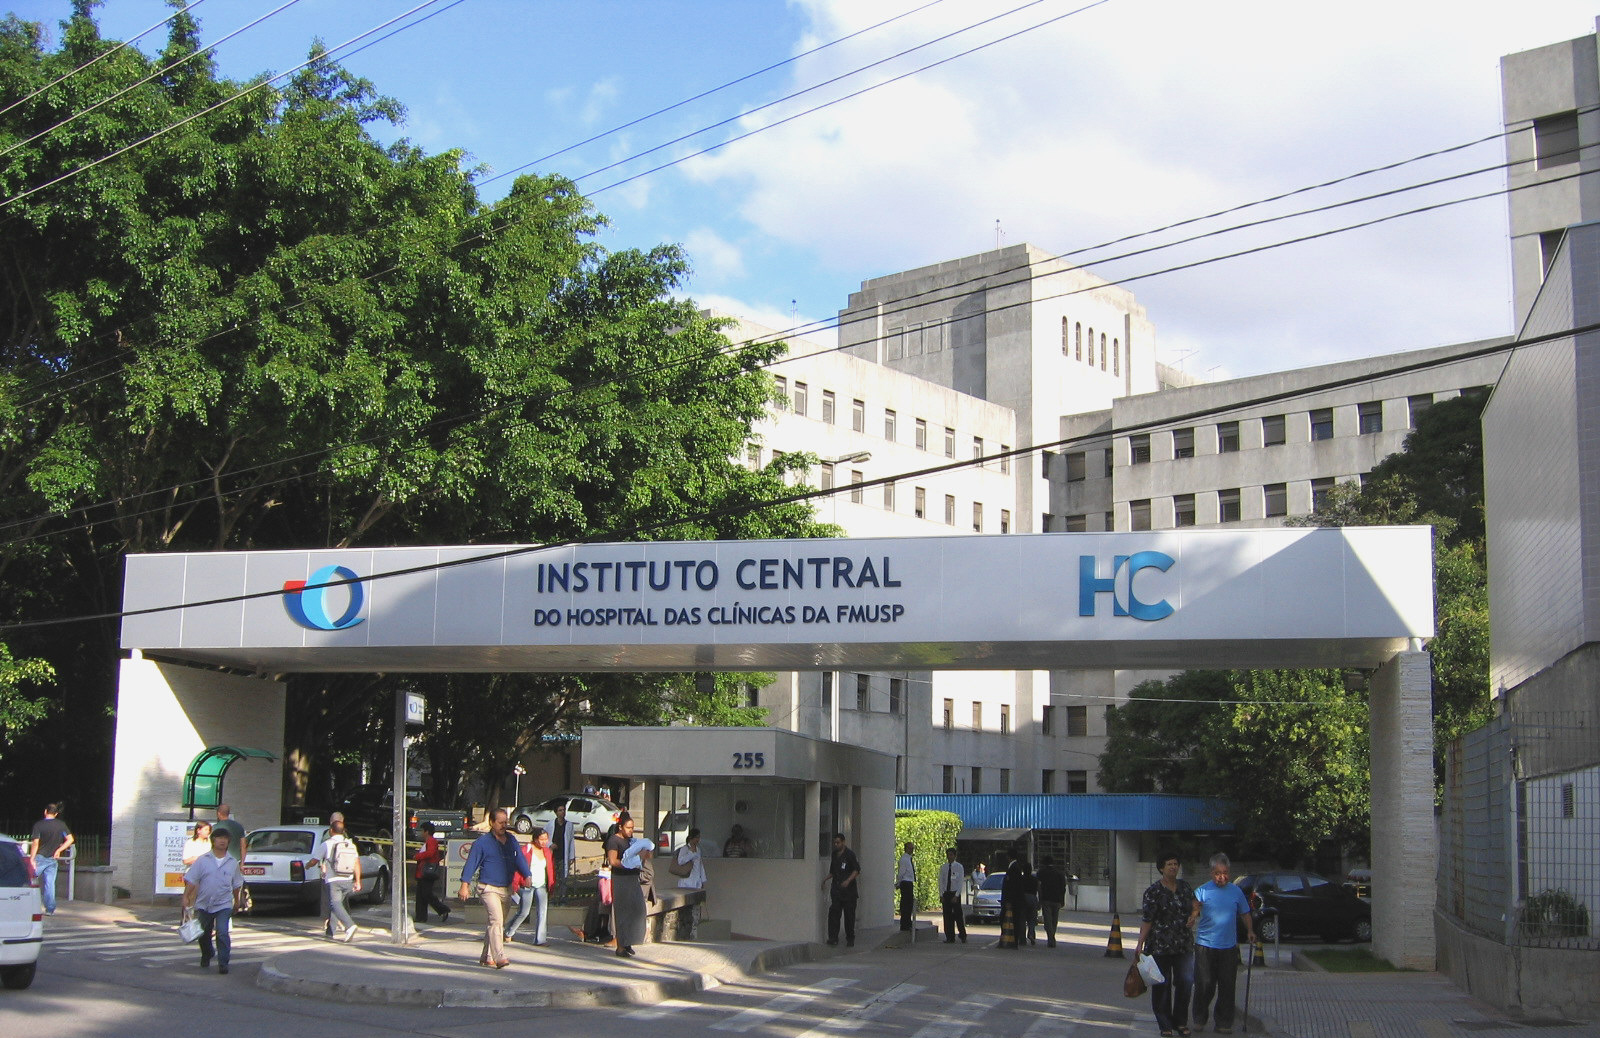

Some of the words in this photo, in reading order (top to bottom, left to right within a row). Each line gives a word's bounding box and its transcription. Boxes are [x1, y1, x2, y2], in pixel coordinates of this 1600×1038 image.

[537, 560, 719, 593] INSTITUTO
[736, 556, 902, 590] CENTRAL
[1079, 551, 1175, 621] HC
[534, 609, 561, 626] DO
[567, 608, 658, 626] HOSPITAL
[664, 607, 701, 625] DAS
[707, 602, 796, 625] CLÍNICAS
[802, 606, 830, 623] DA
[837, 604, 904, 623] FMUSP
[733, 752, 764, 768] 255
